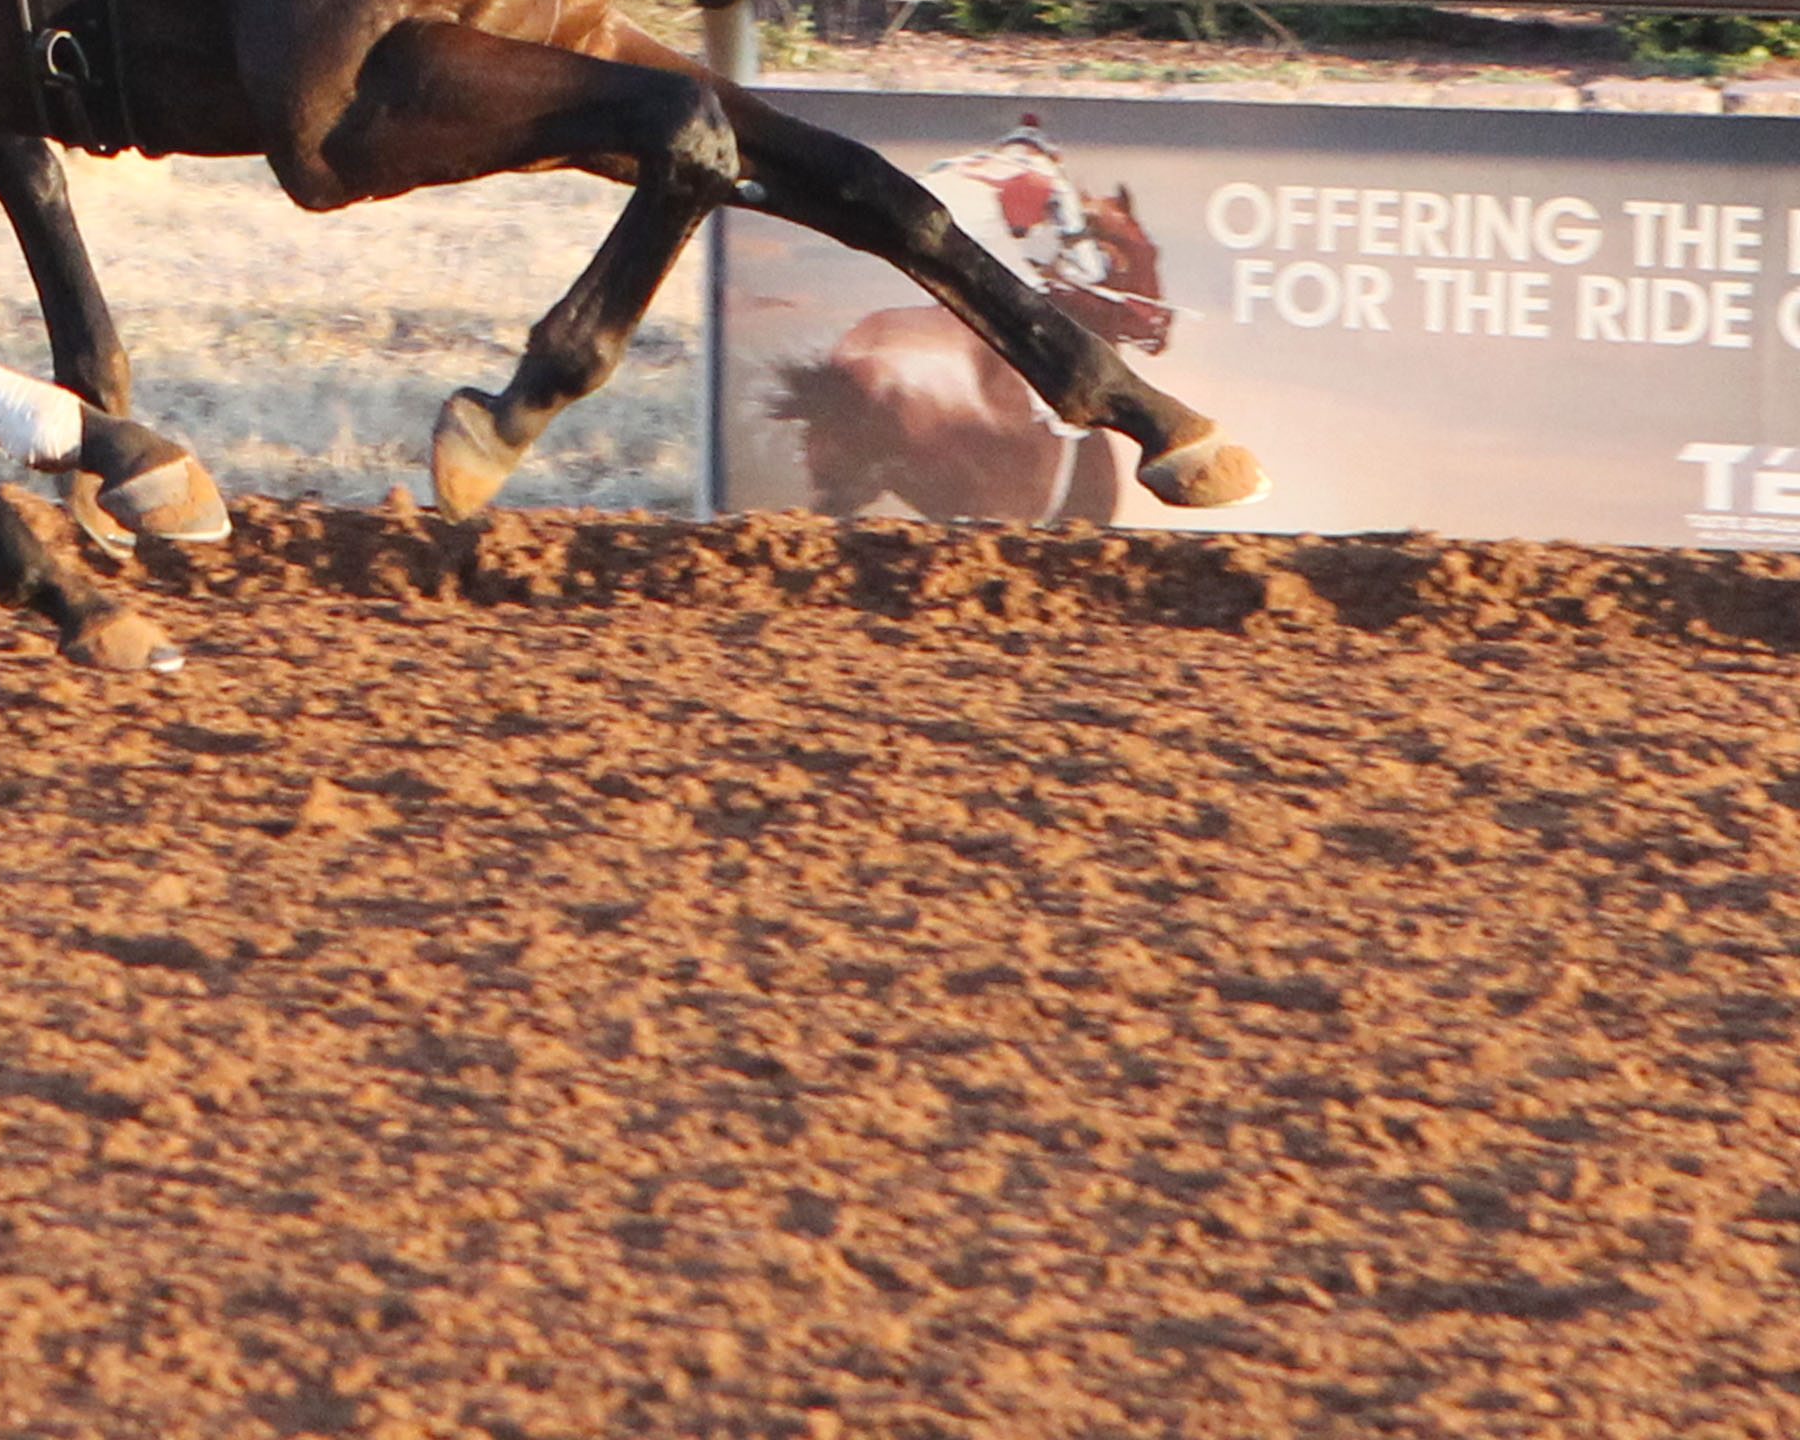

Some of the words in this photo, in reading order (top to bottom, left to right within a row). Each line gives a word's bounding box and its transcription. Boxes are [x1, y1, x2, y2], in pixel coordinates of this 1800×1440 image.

[1205, 182, 1602, 264] OFFERING
[1623, 200, 1764, 273] THE
[1233, 259, 1394, 331] FOR
[1415, 267, 1551, 339] THE
[1577, 276, 1754, 349] RIDE
